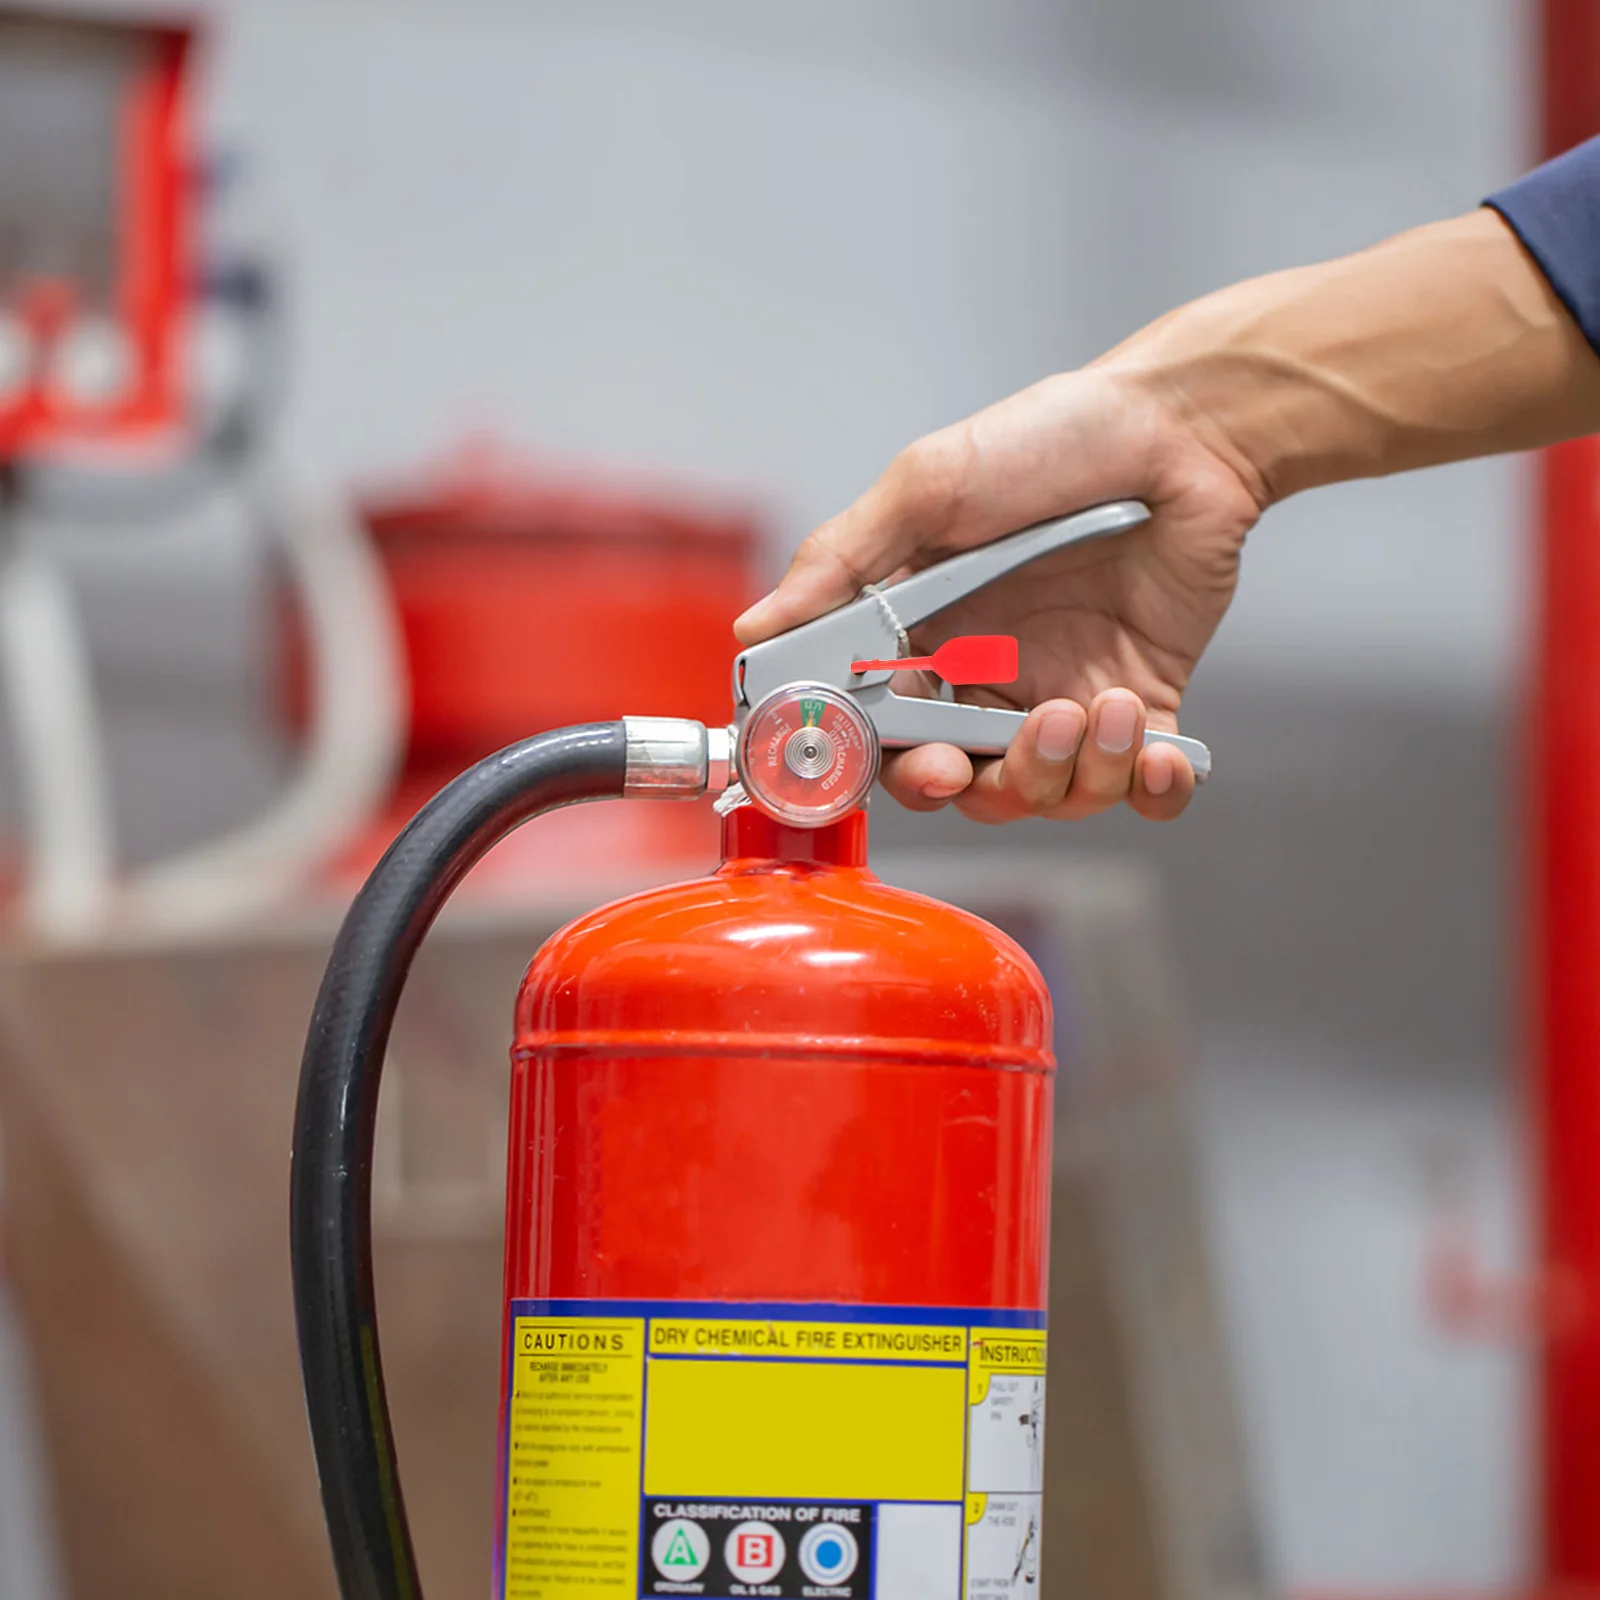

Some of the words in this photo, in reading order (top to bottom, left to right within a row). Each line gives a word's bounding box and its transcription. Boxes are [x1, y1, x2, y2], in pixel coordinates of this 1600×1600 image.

[523, 1332, 624, 1351] CAUTIONS
[654, 1327, 689, 1345] DRY
[694, 1327, 789, 1348] CHEMICAL
[795, 1330, 836, 1349] FIRE
[842, 1331, 962, 1352] EXTINGUISHER
[653, 1502, 791, 1521] CLASSIFICATION
[794, 1505, 820, 1521] OF
[822, 1507, 861, 1523] FIRE
